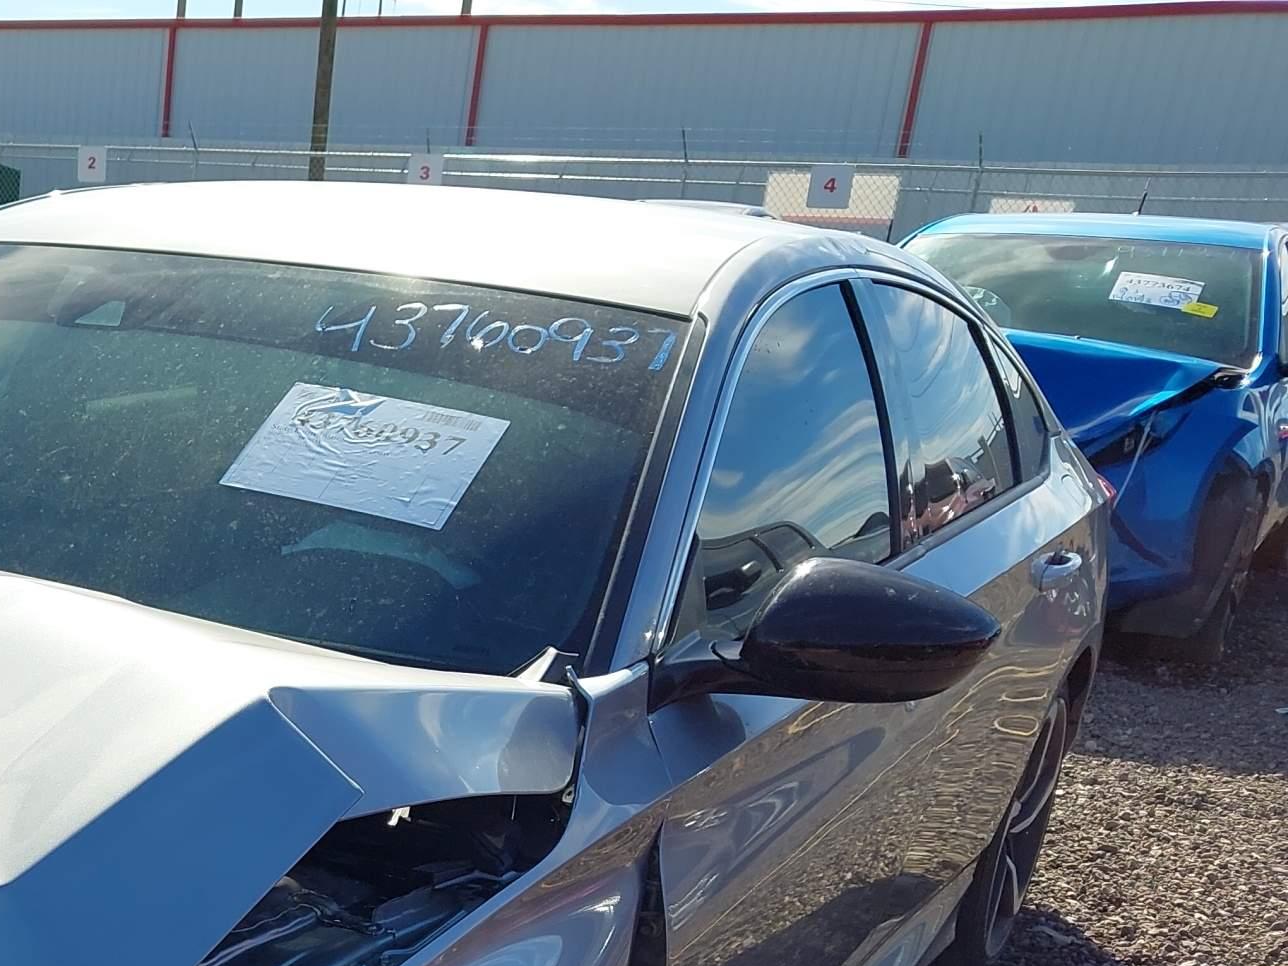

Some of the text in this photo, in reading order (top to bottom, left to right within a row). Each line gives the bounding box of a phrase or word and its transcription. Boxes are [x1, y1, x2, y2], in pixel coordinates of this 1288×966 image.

[87, 156, 98, 169] 2
[419, 166, 431, 181] 3
[823, 177, 837, 193] 4
[314, 301, 678, 371] 43760937
